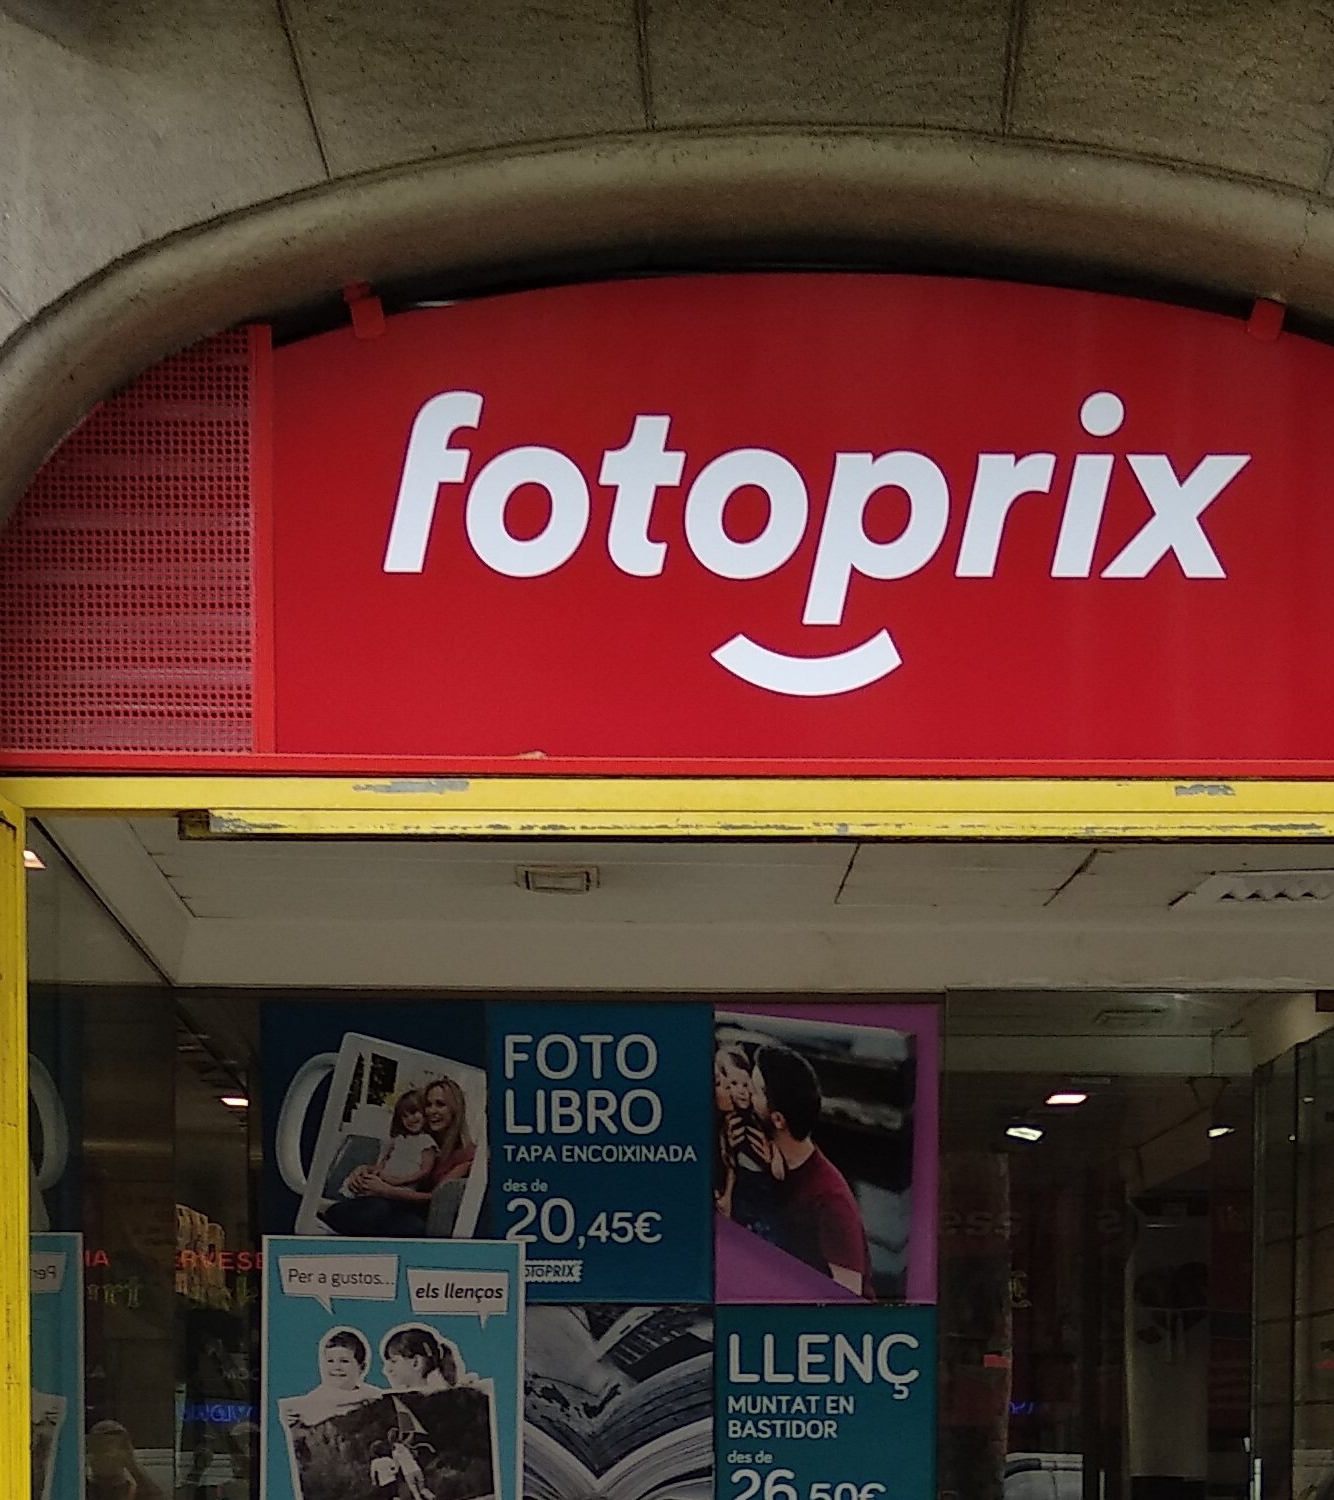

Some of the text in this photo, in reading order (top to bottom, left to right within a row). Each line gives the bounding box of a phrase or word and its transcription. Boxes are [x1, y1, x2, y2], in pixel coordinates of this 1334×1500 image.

[383, 390, 1251, 626] fotoprix
[504, 1034, 658, 1080] FOTO
[505, 1088, 662, 1135] LIBRO
[503, 1145, 698, 1162] TAPA ENCOIXINADA
[503, 1179, 548, 1192] des de
[505, 1197, 663, 1249] 20,45€
[288, 1269, 312, 1283] Per
[318, 1273, 327, 1284] a
[415, 1282, 504, 1303] els llenços
[729, 1333, 919, 1399] LLENÇ
[727, 1395, 854, 1414] MUNTAT EN
[727, 1420, 838, 1439] BASTIDOR
[727, 1450, 773, 1464] des de
